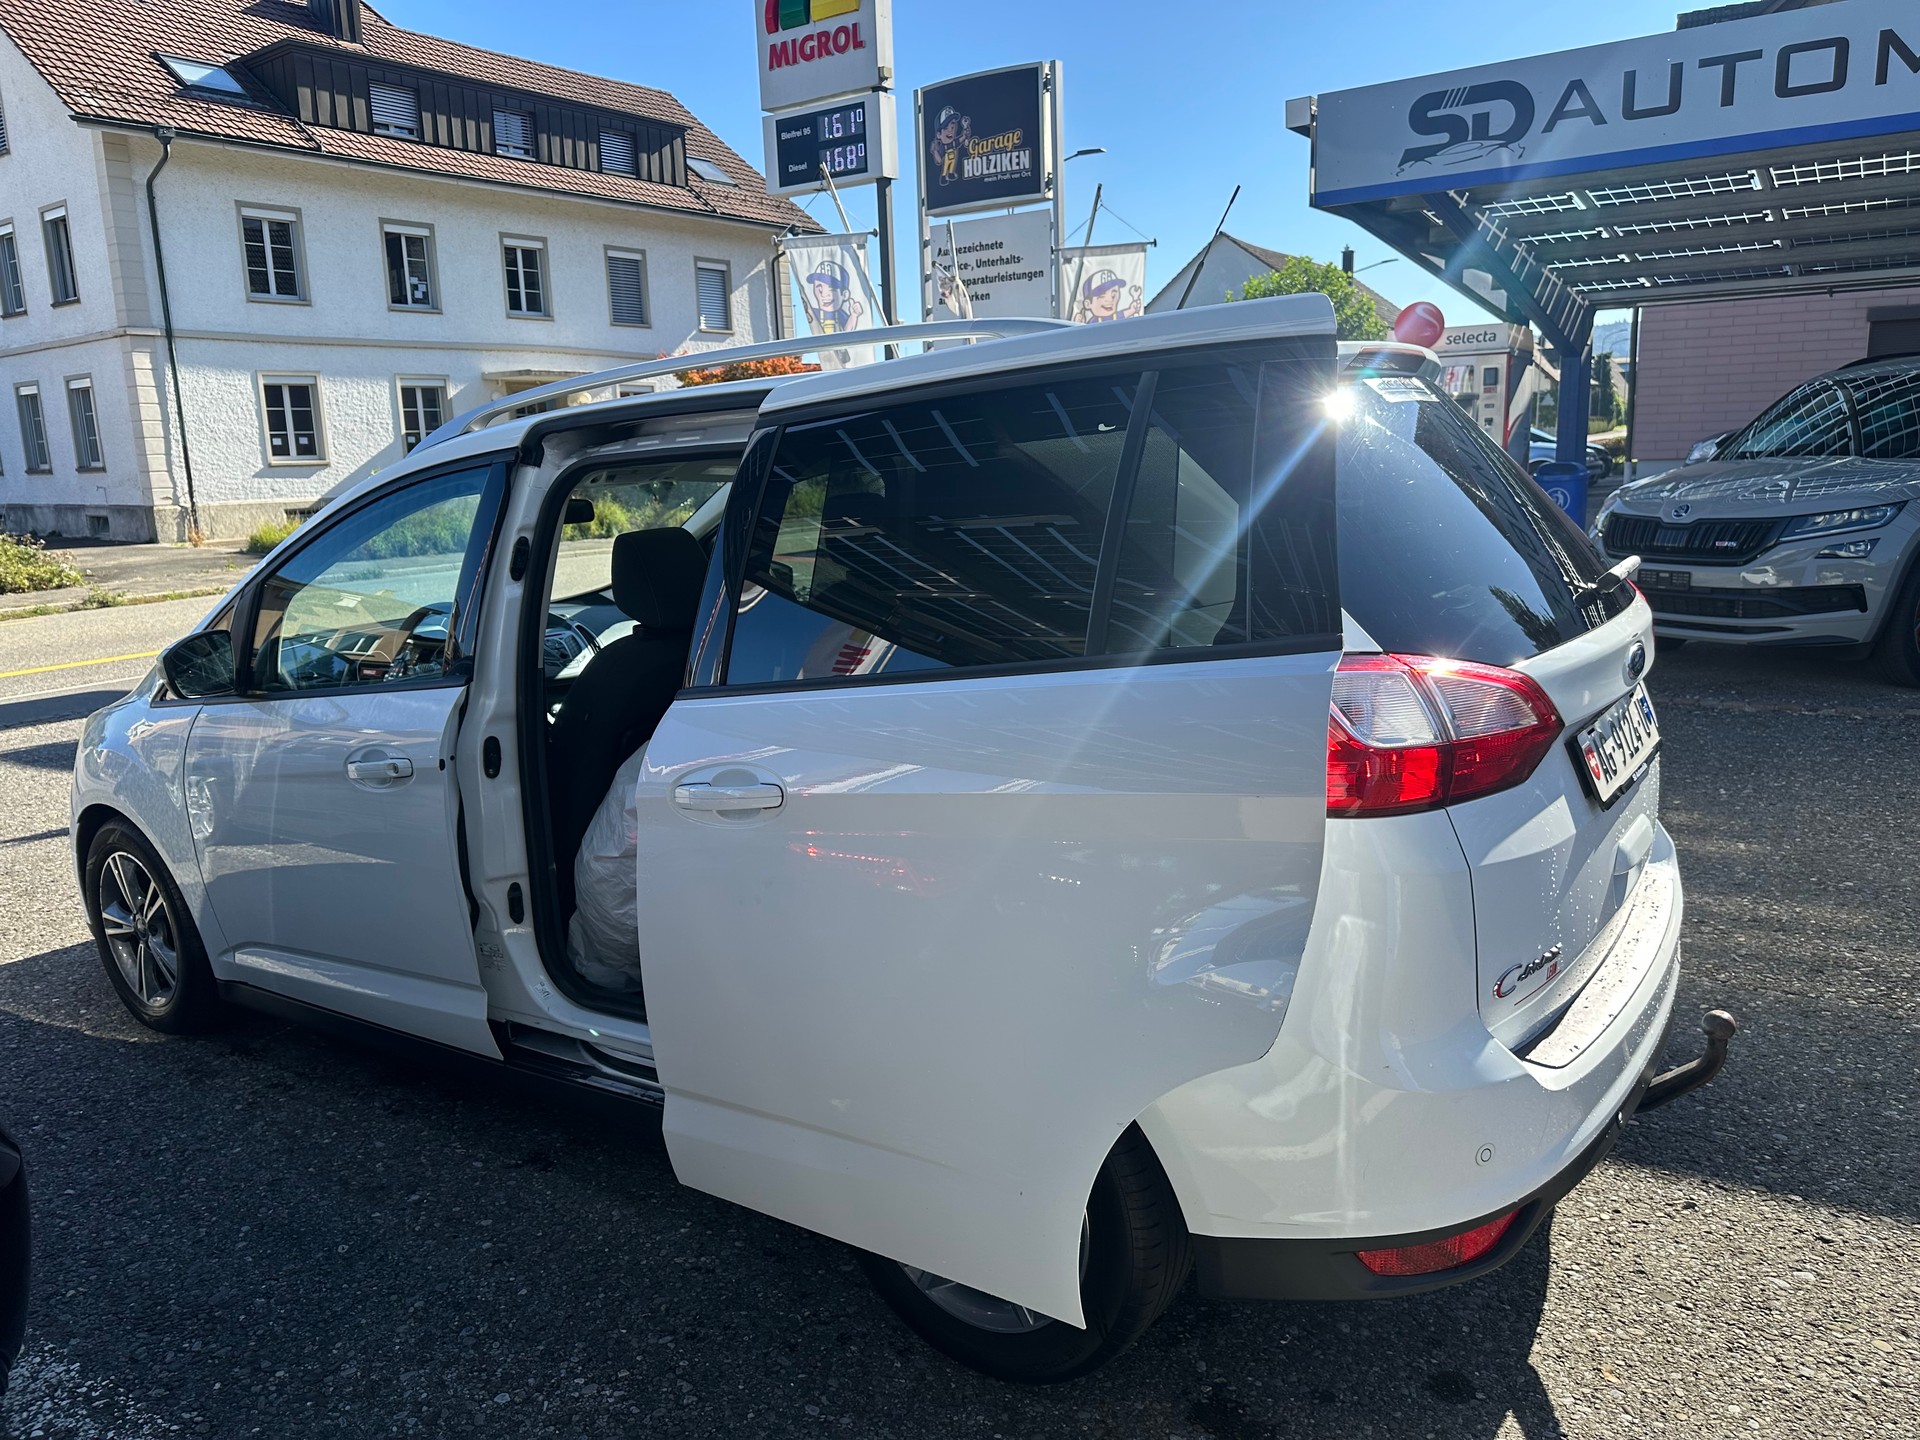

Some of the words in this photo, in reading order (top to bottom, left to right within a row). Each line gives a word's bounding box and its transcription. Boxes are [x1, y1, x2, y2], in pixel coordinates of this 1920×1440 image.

[769, 22, 864, 71] MIGROL
[781, 128, 802, 140] Bleifrei
[803, 127, 811, 136] 95
[969, 130, 1021, 157] Garage
[788, 162, 807, 172] Diesel
[963, 150, 1030, 178] HOLZIKEN
[975, 254, 1024, 269] Unterhalts-
[1445, 330, 1497, 345] selecta
